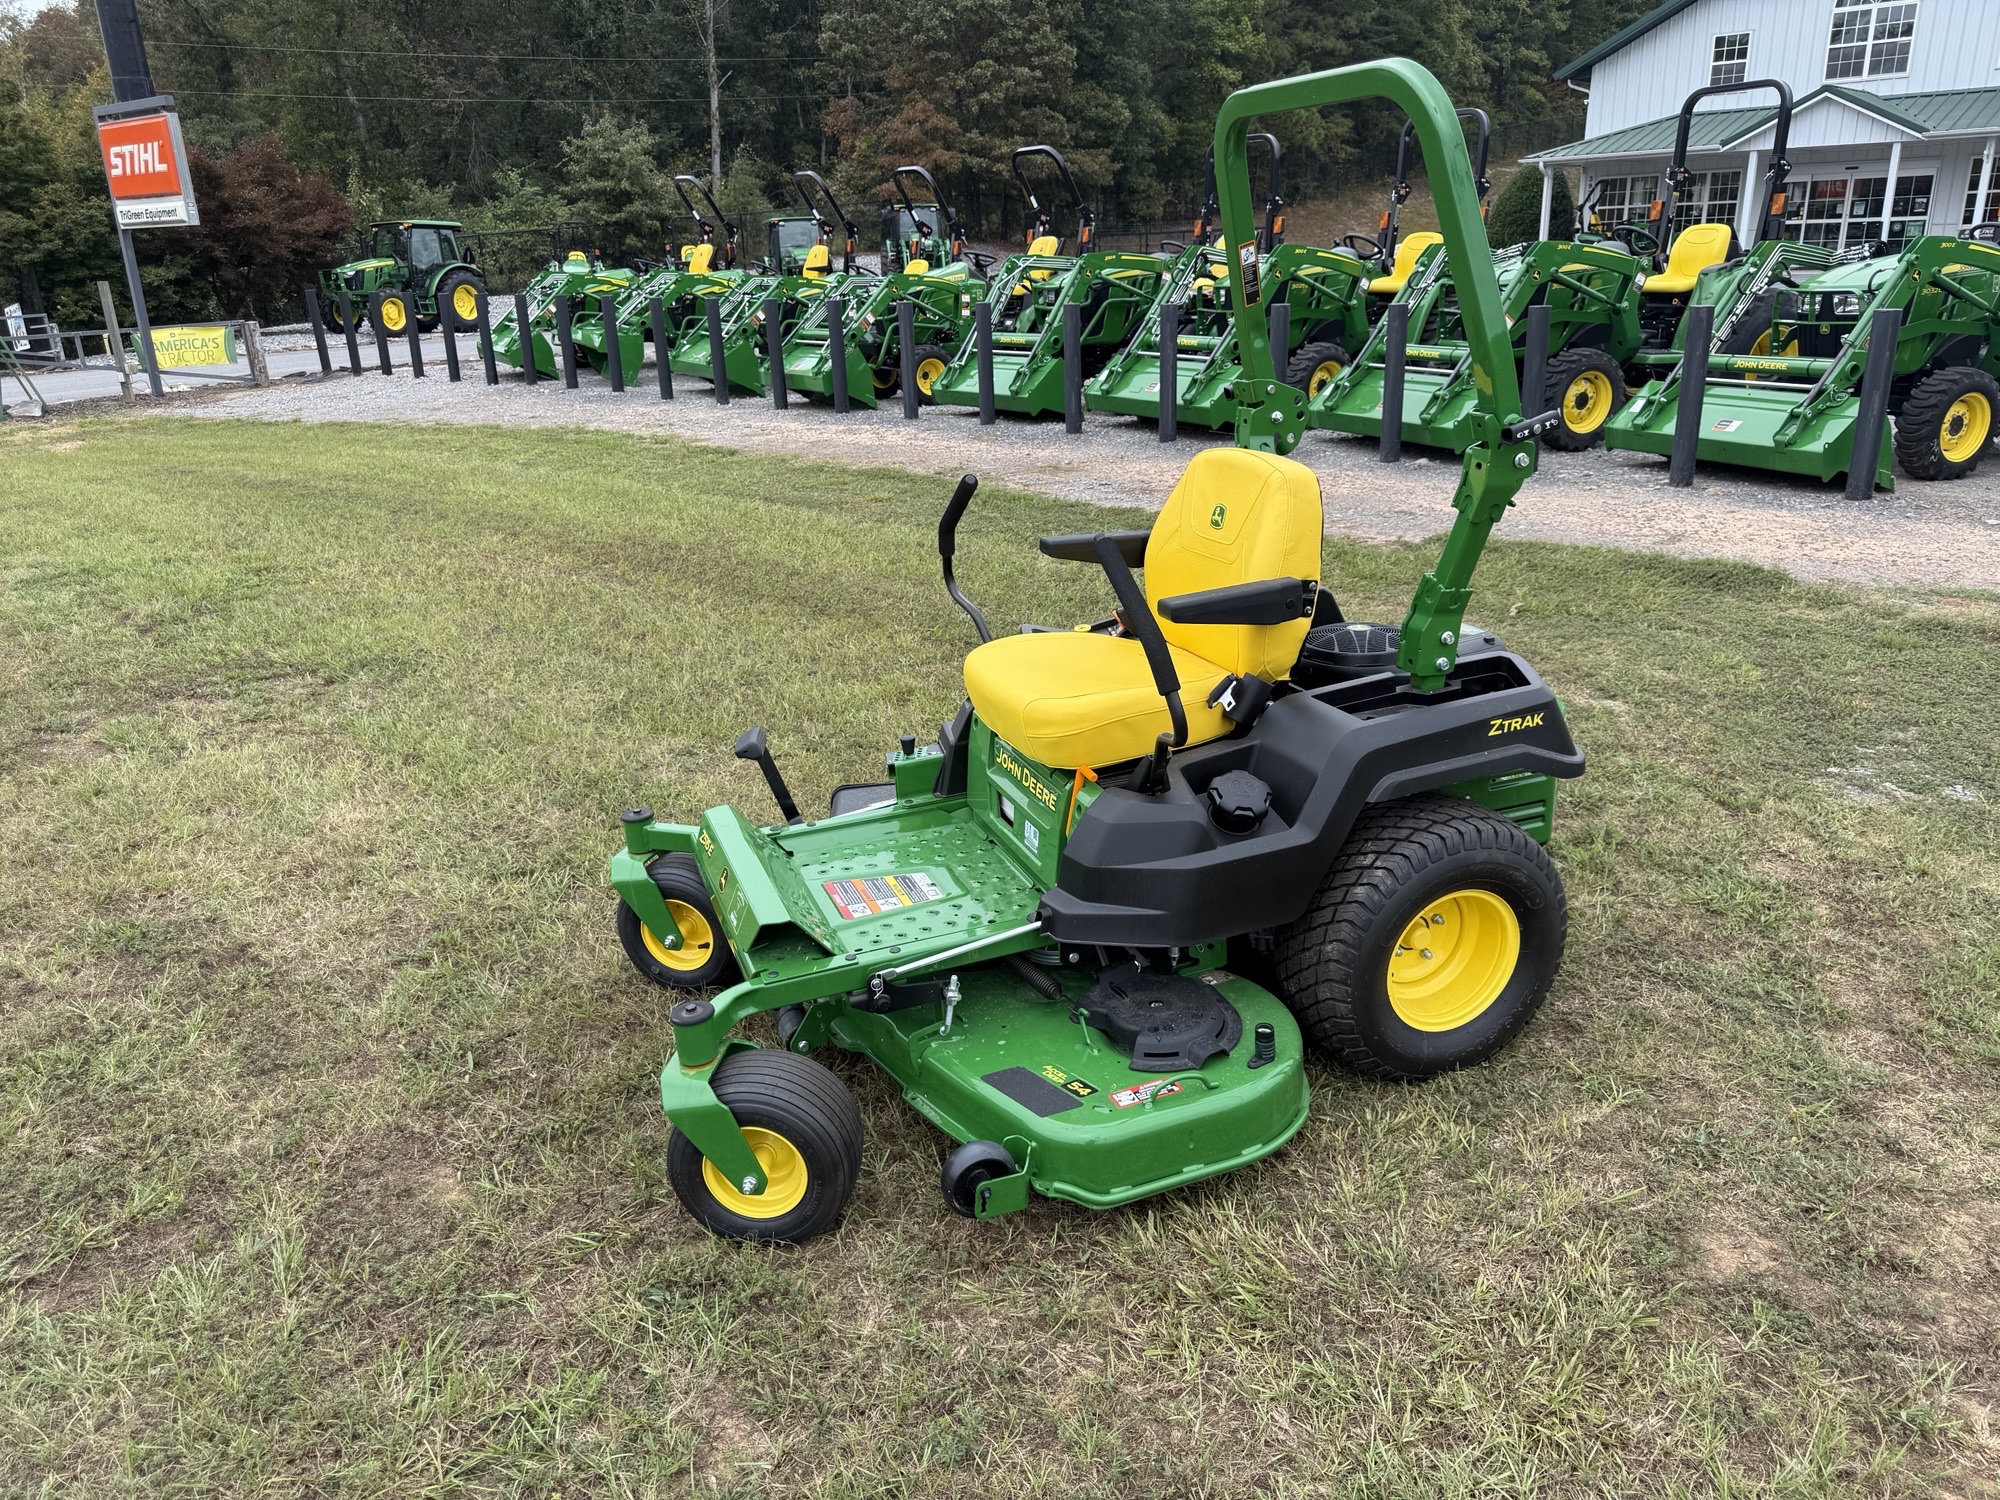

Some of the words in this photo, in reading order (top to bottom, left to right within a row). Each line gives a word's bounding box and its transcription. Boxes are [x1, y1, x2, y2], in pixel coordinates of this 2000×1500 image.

[110, 142, 168, 177] STIHL
[119, 209, 144, 221] TriGreen
[145, 207, 178, 221] Equipment
[153, 337, 220, 354] AMERICA'S
[1406, 349, 1420, 357] OHN
[160, 349, 215, 365] TRACTOR
[1734, 359, 1757, 369] JOHN
[1758, 360, 1788, 370] DEERE
[1488, 712, 1544, 736] ZTRAK
[996, 747, 1021, 780] JOHN
[1022, 767, 1057, 812] DEERE
[1066, 1081, 1092, 1096] 54
